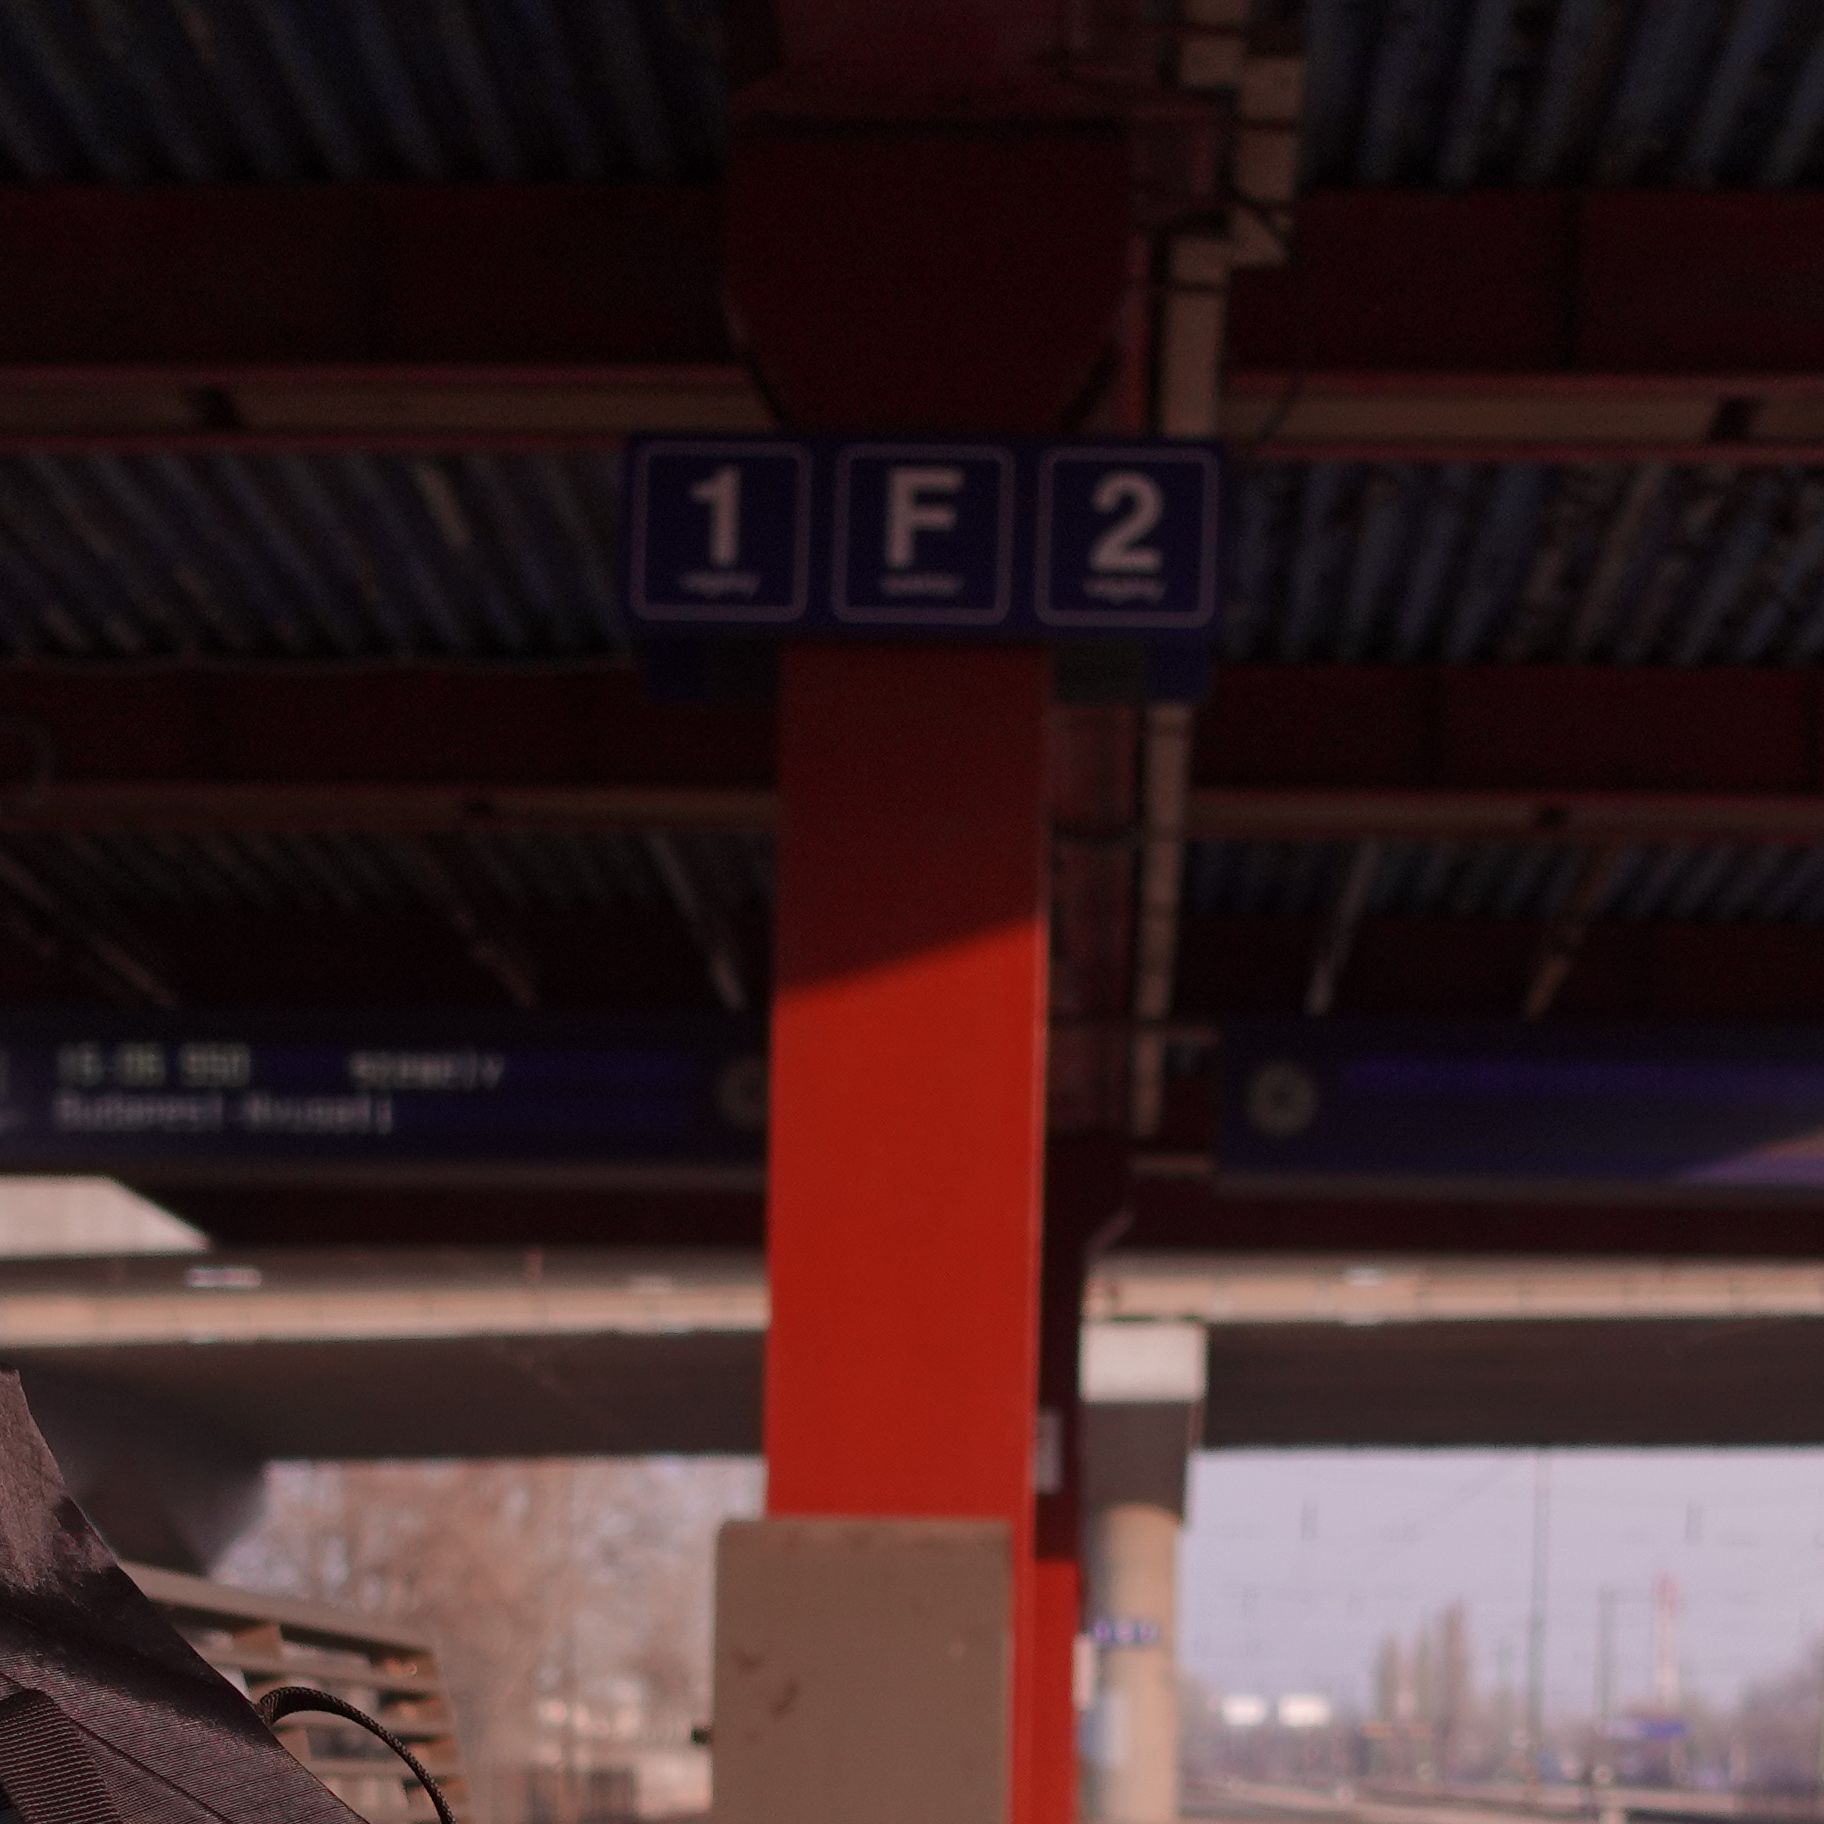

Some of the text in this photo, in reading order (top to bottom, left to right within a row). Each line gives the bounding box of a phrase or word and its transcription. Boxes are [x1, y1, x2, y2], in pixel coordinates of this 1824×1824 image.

[689, 464, 1163, 572] 1 F 2
